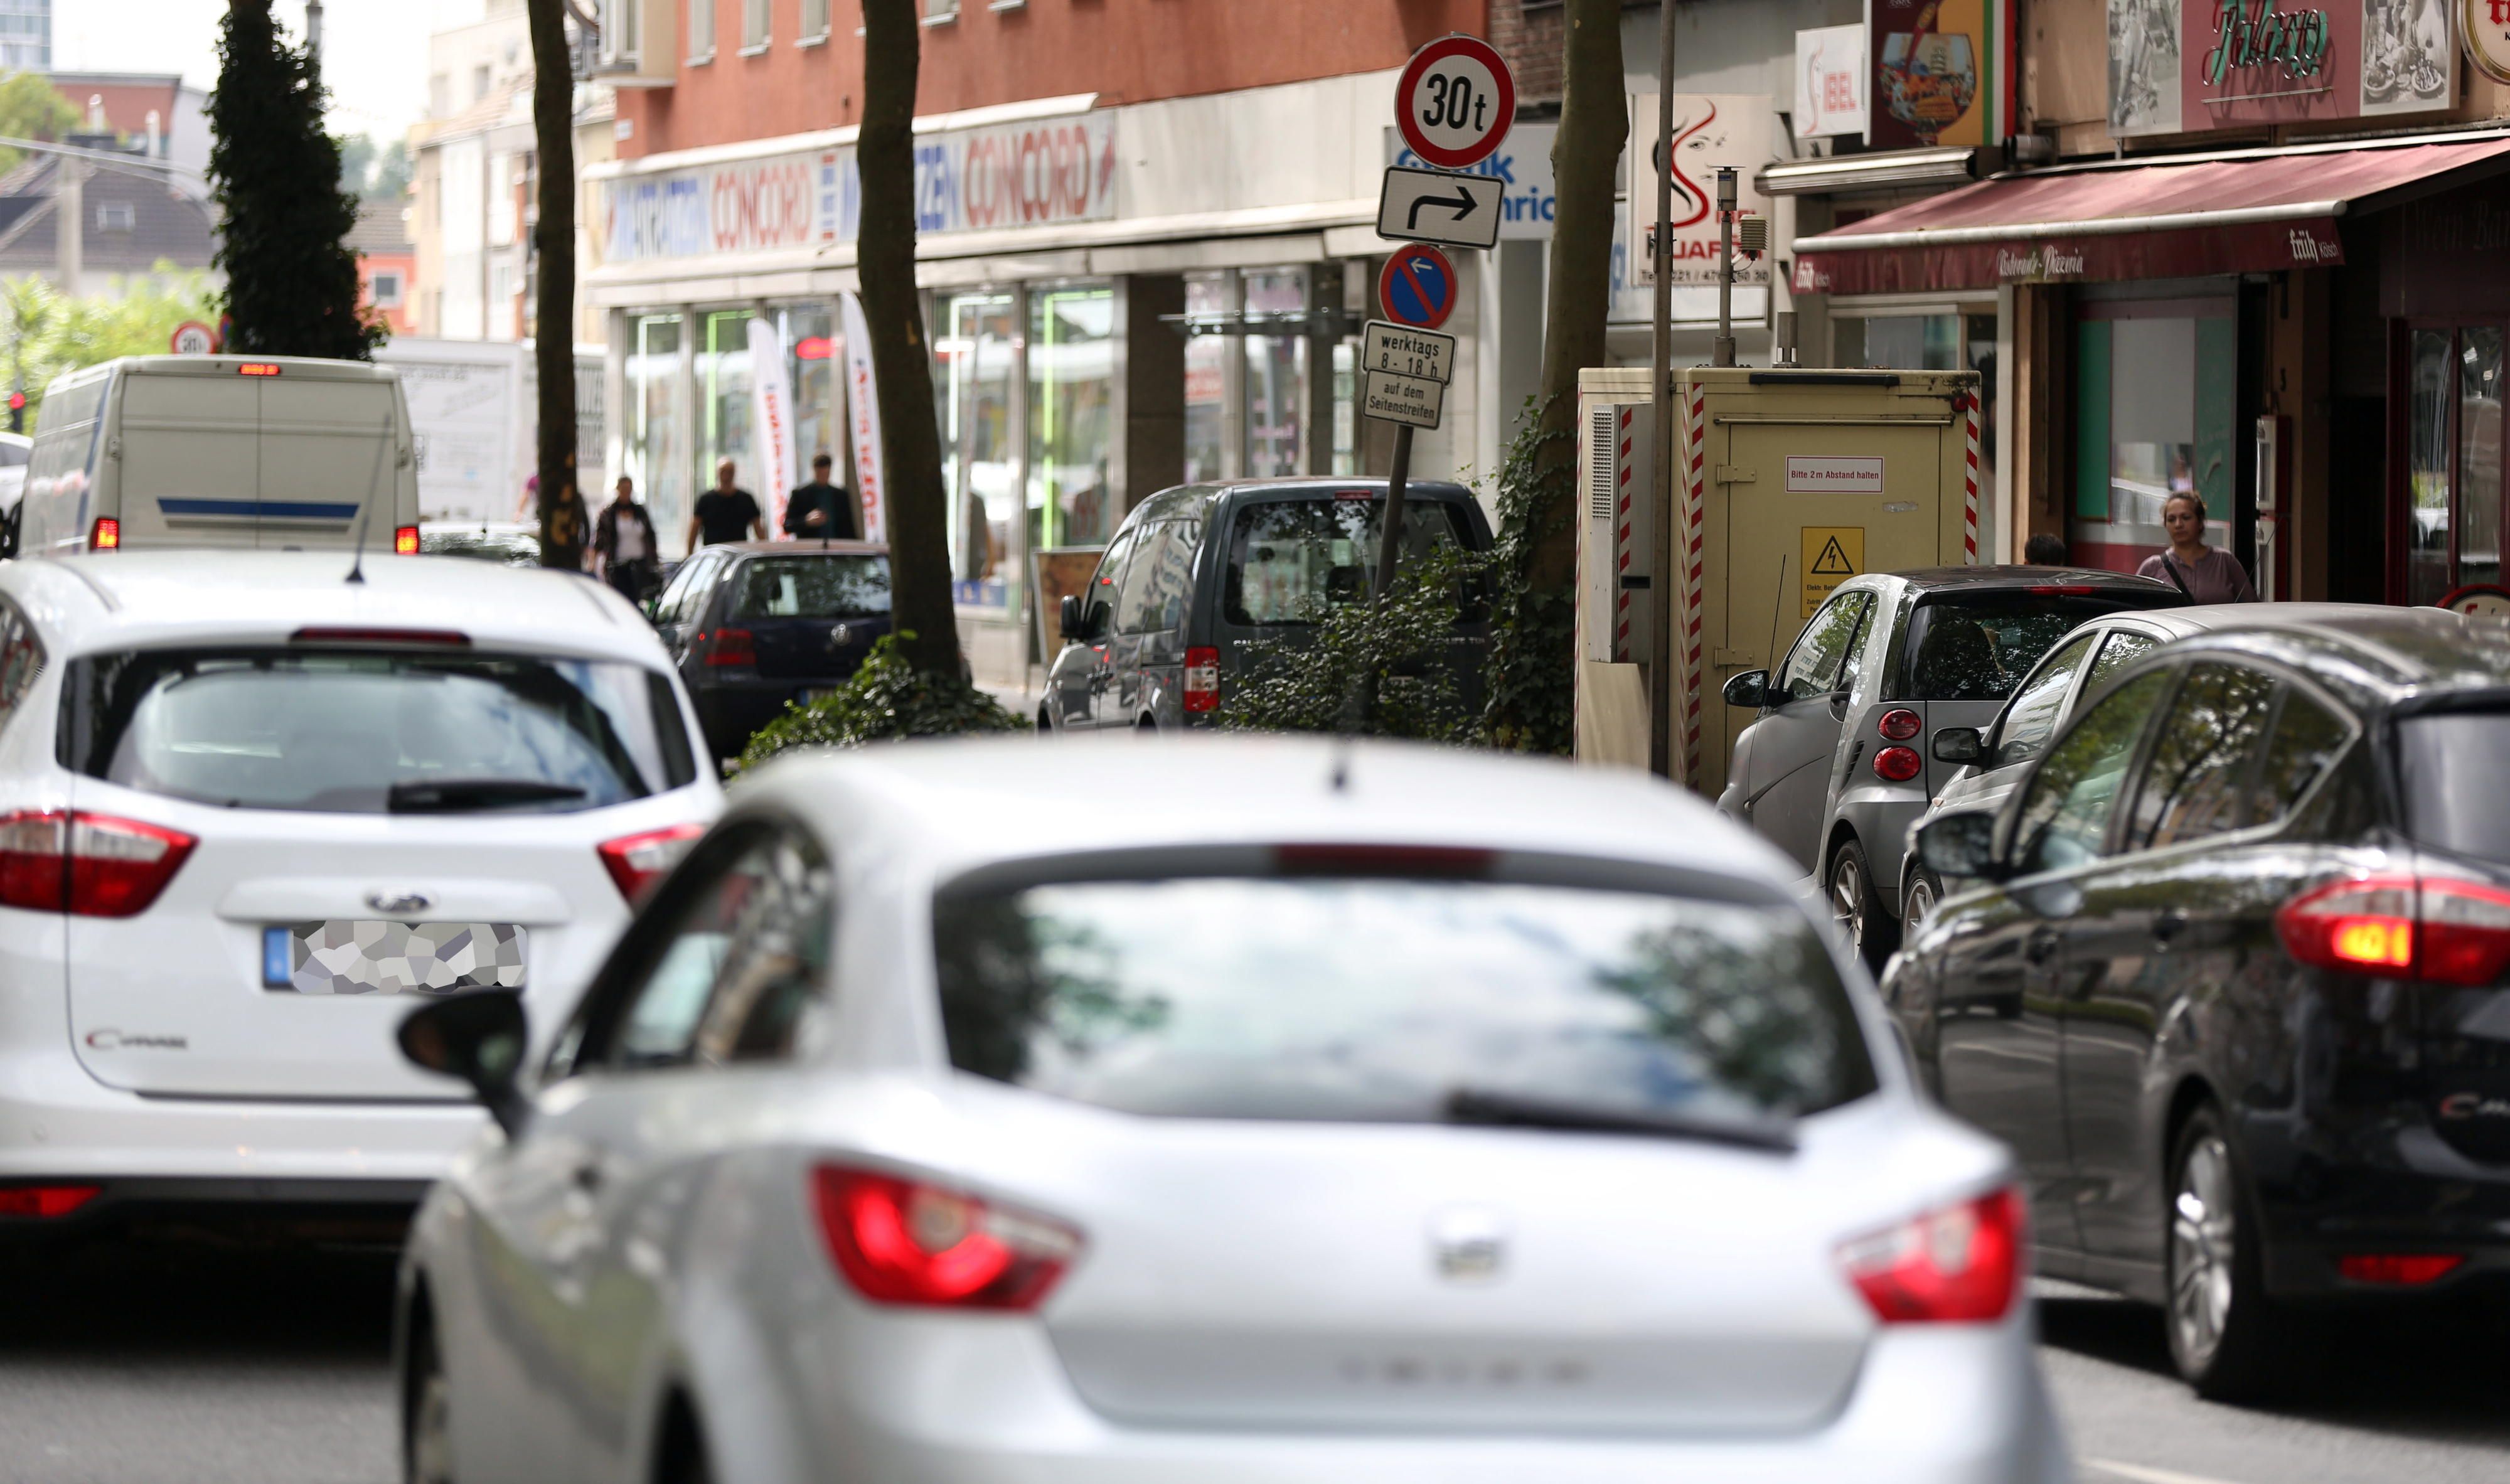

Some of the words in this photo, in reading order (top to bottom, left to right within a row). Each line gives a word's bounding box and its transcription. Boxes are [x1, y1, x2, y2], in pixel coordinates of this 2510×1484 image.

[964, 123, 1091, 228] CONCORD
[712, 161, 814, 250] CONCORD
[2043, 245, 2083, 280] Pizzeria
[1382, 335, 1440, 360] werktags
[1381, 353, 1389, 369] 8
[1407, 357, 1423, 375] 18
[1430, 361, 1438, 378] h
[1384, 382, 1401, 395] auf
[1404, 385, 1424, 400] dem
[1369, 395, 1435, 419] Seitenstreifen
[1825, 471, 1855, 479] Abstand
[1857, 471, 1879, 479] halten
